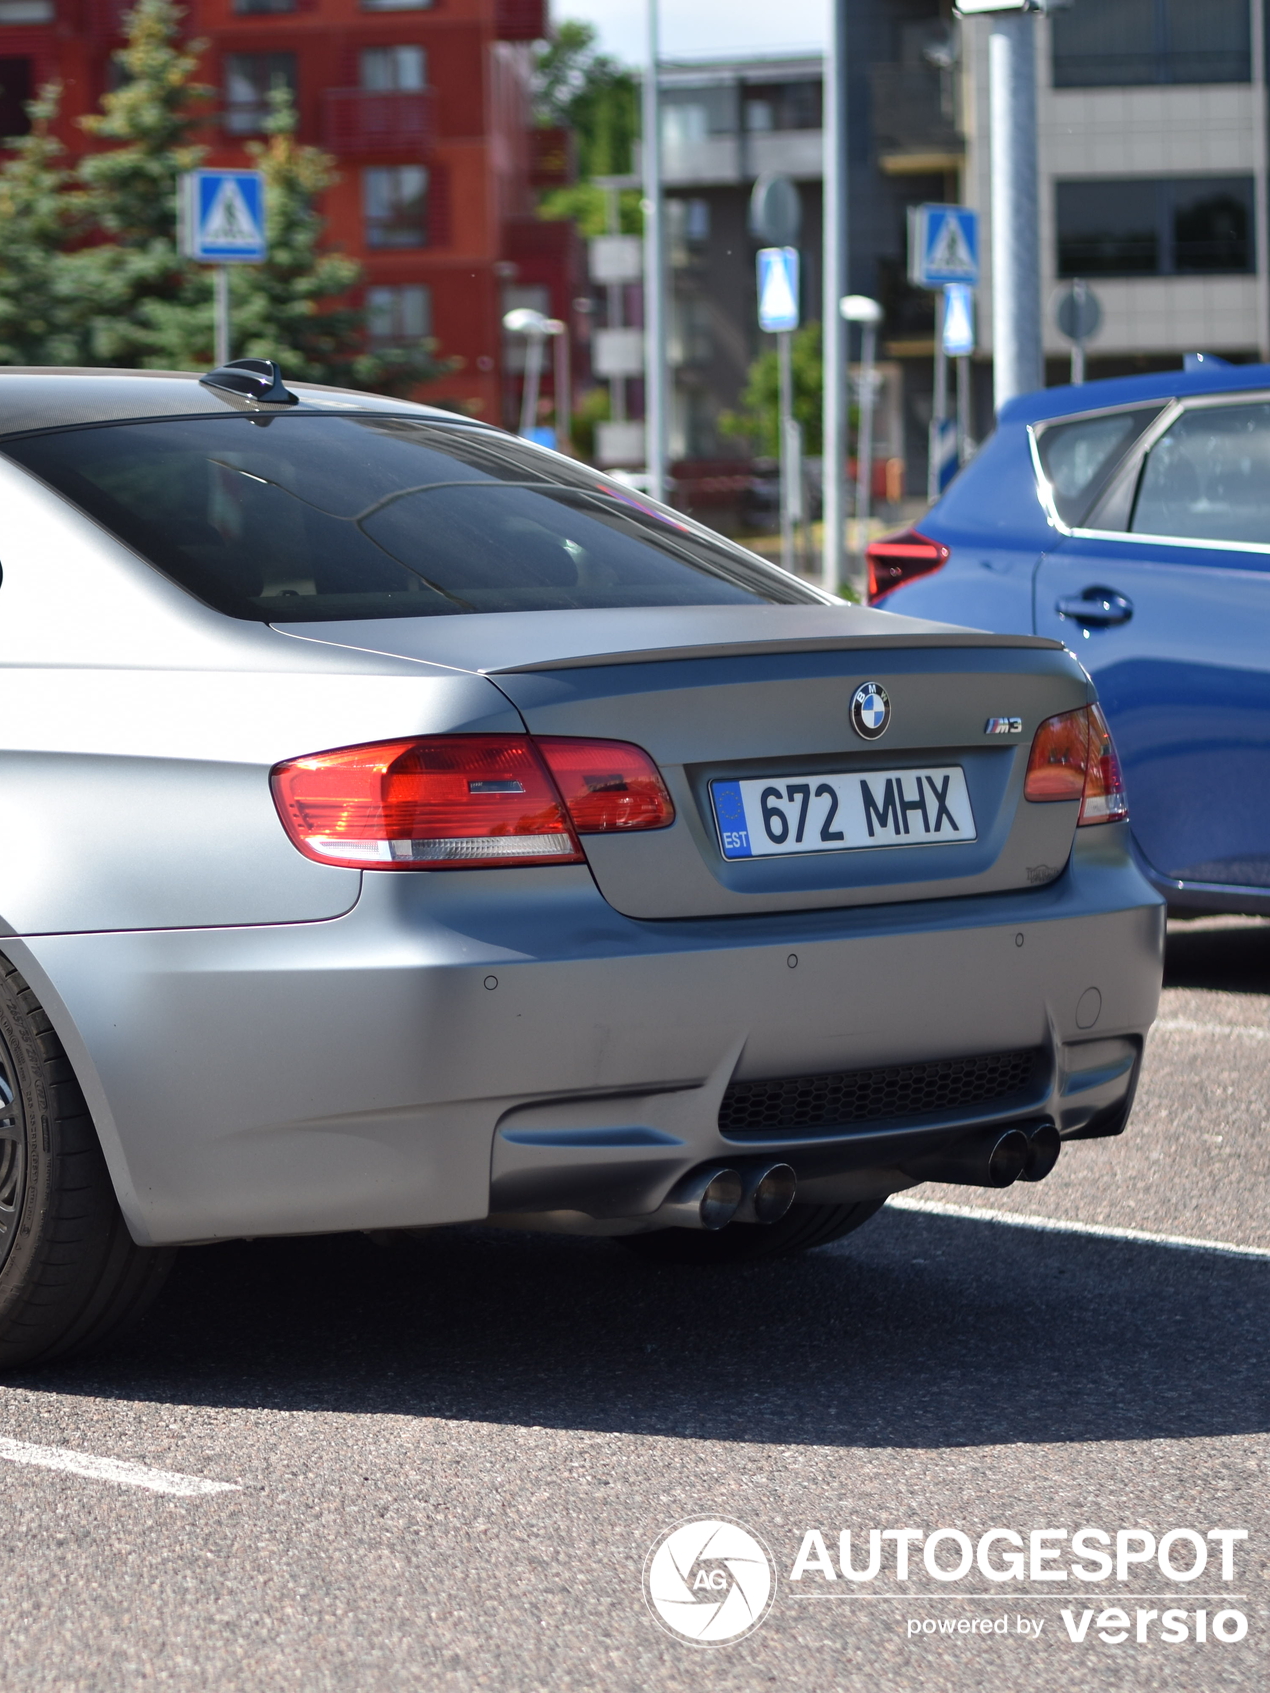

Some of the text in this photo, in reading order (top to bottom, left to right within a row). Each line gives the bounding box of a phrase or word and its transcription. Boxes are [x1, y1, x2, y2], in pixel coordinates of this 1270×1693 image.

[856, 684, 888, 703] BMW
[986, 717, 1023, 734] M3
[760, 775, 960, 845] 672 MHX
[723, 831, 748, 849] EST
